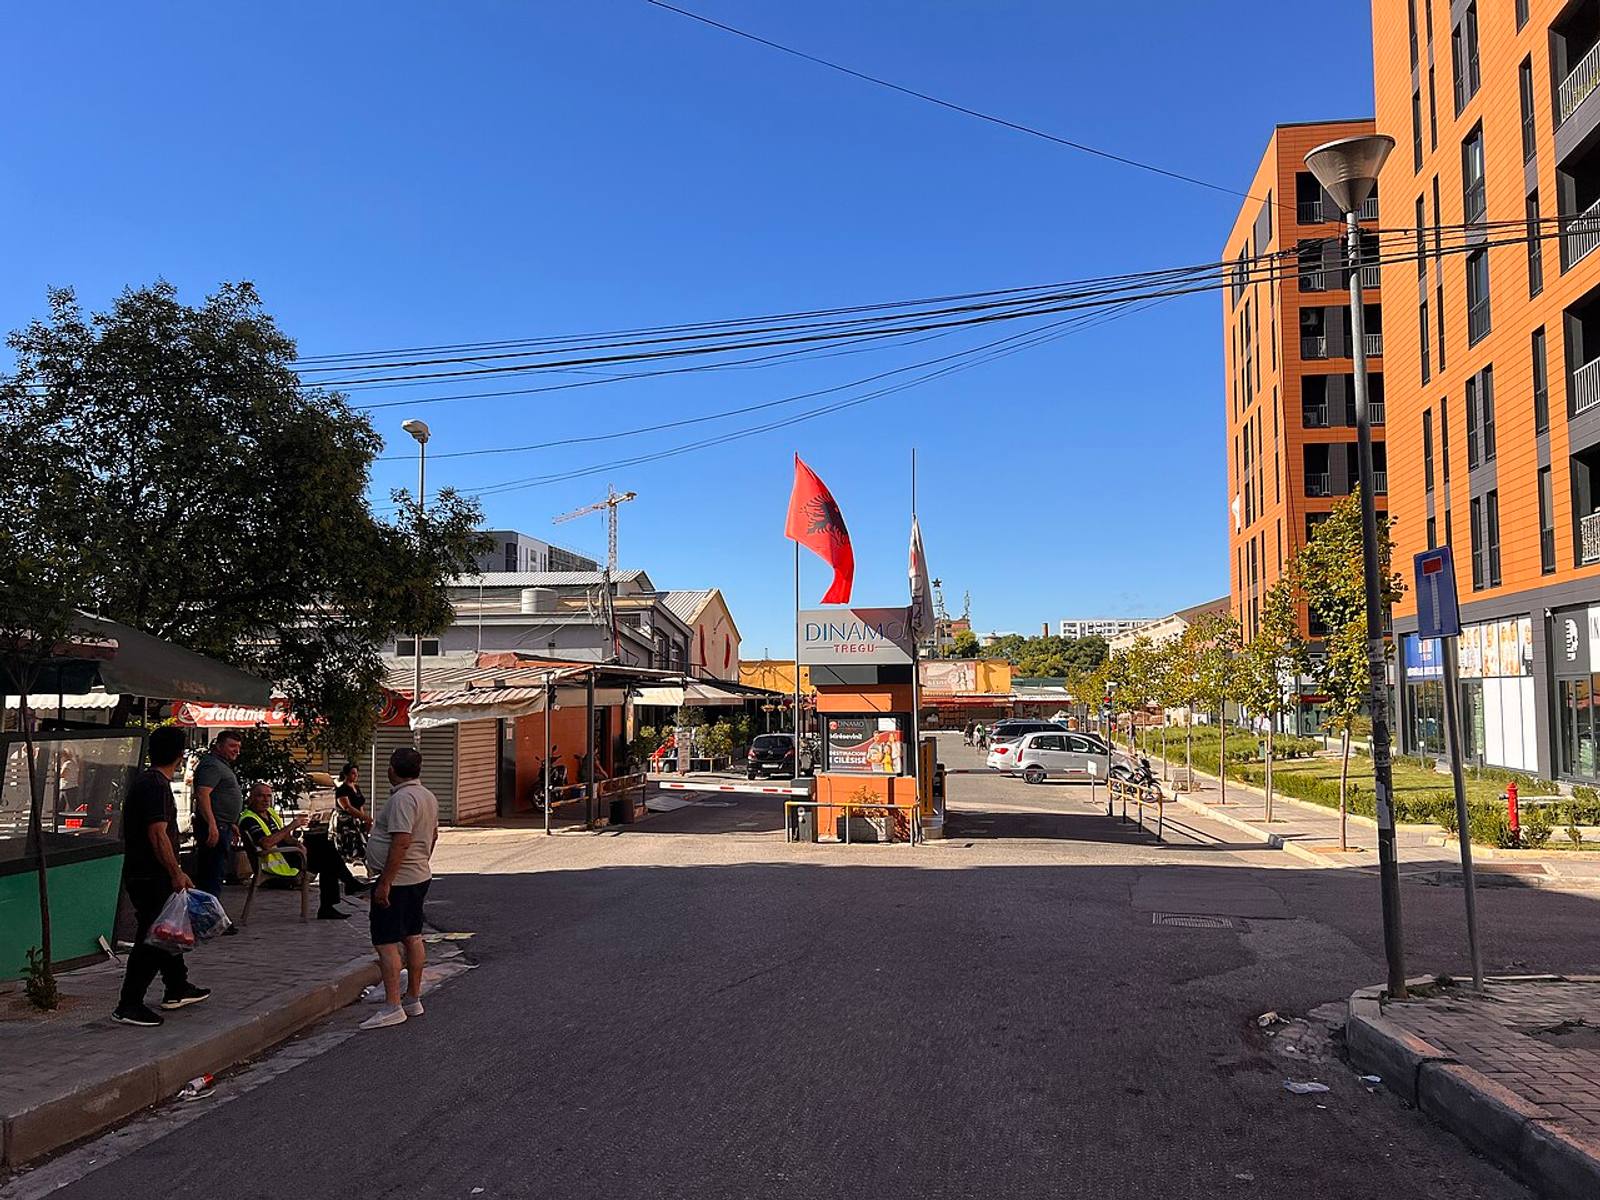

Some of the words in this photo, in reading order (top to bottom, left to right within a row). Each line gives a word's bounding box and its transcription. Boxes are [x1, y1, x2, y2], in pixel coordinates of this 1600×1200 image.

[806, 622, 903, 641] DINAMO
[833, 643, 875, 653] TREGU
[838, 720, 865, 728] DINAMO
